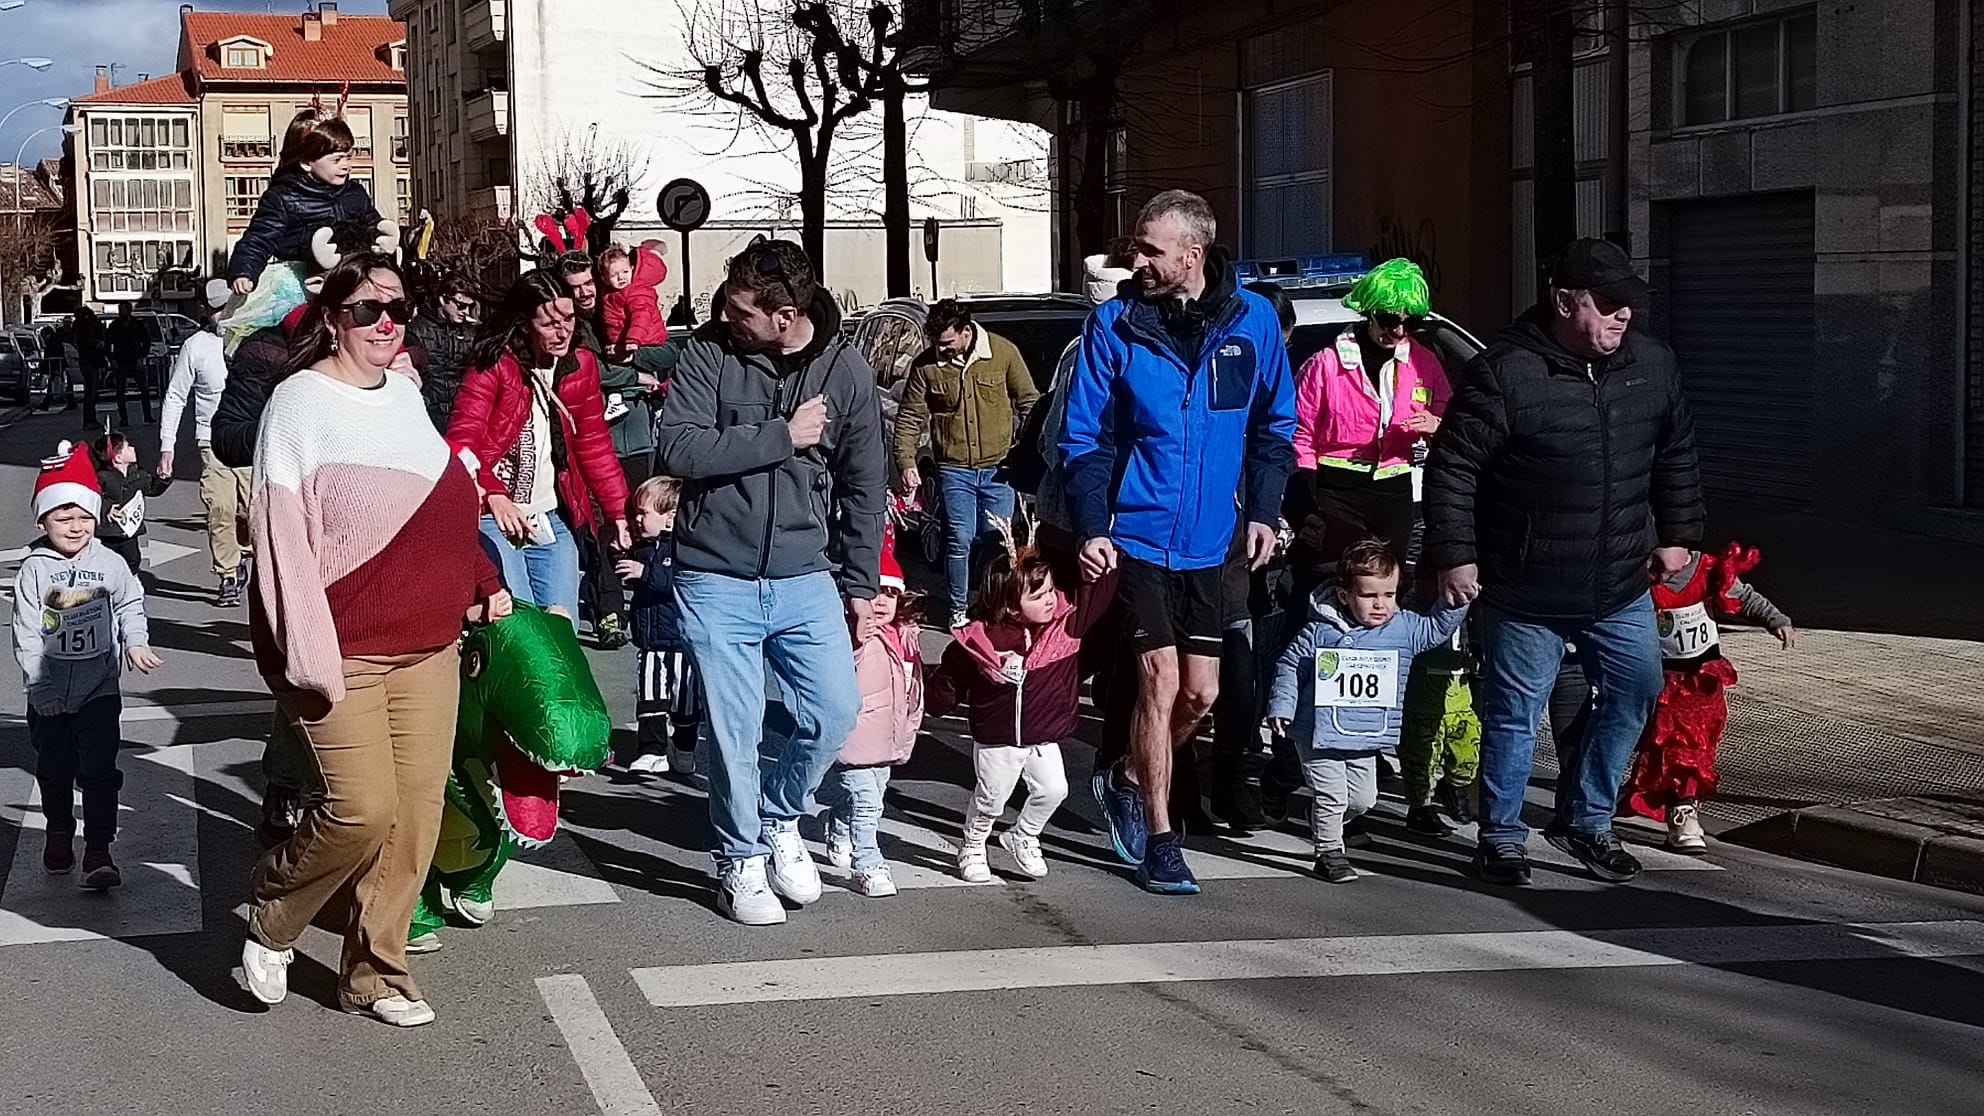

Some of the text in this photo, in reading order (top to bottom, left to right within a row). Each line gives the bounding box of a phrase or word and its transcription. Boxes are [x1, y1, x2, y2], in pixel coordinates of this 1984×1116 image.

[57, 625, 96, 652] 151
[1673, 622, 1708, 651] 178
[1334, 673, 1379, 698] 108
